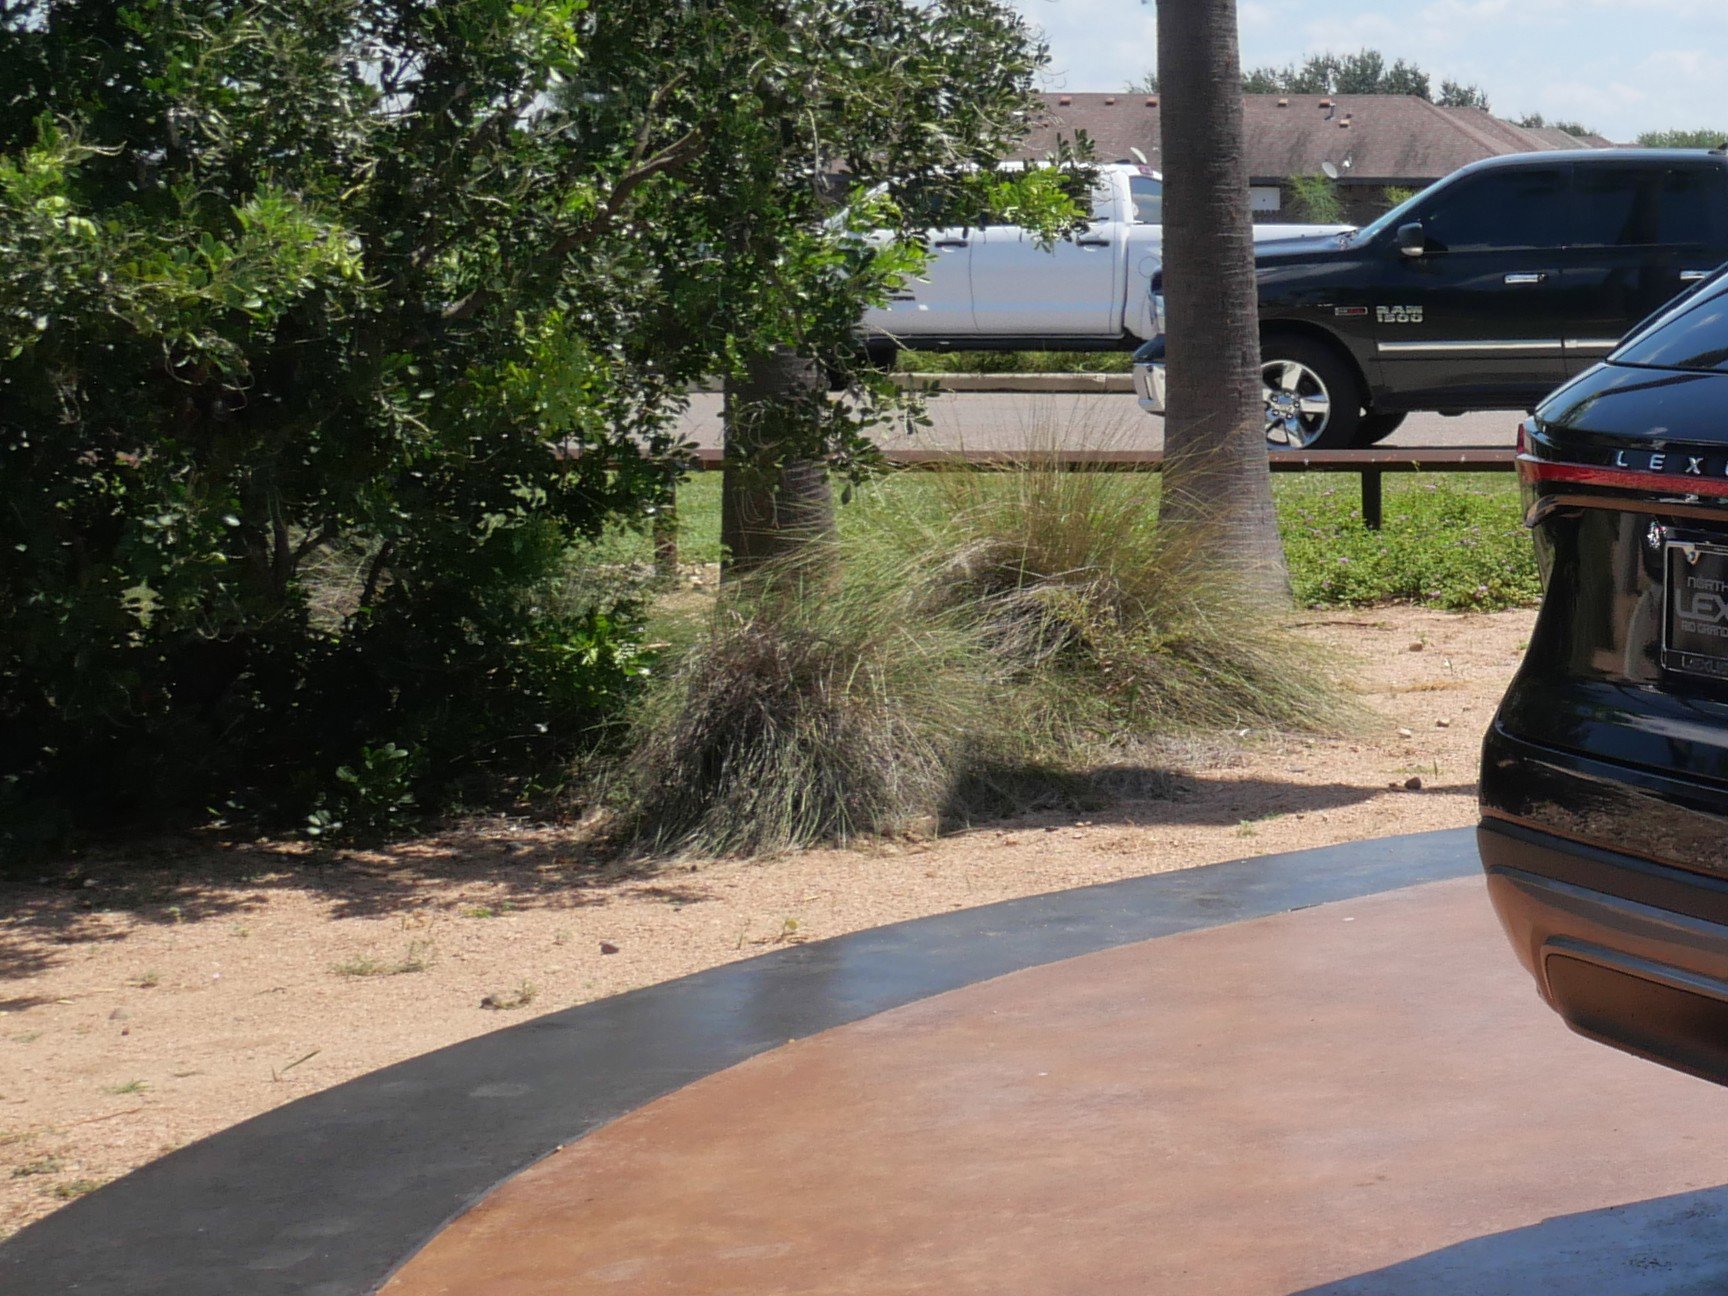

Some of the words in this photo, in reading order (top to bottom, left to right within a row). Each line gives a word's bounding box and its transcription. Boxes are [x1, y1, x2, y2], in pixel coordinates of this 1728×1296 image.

[1376, 305, 1423, 315] RAM
[1377, 313, 1423, 323] 1500
[1681, 620, 1696, 633] RIO
